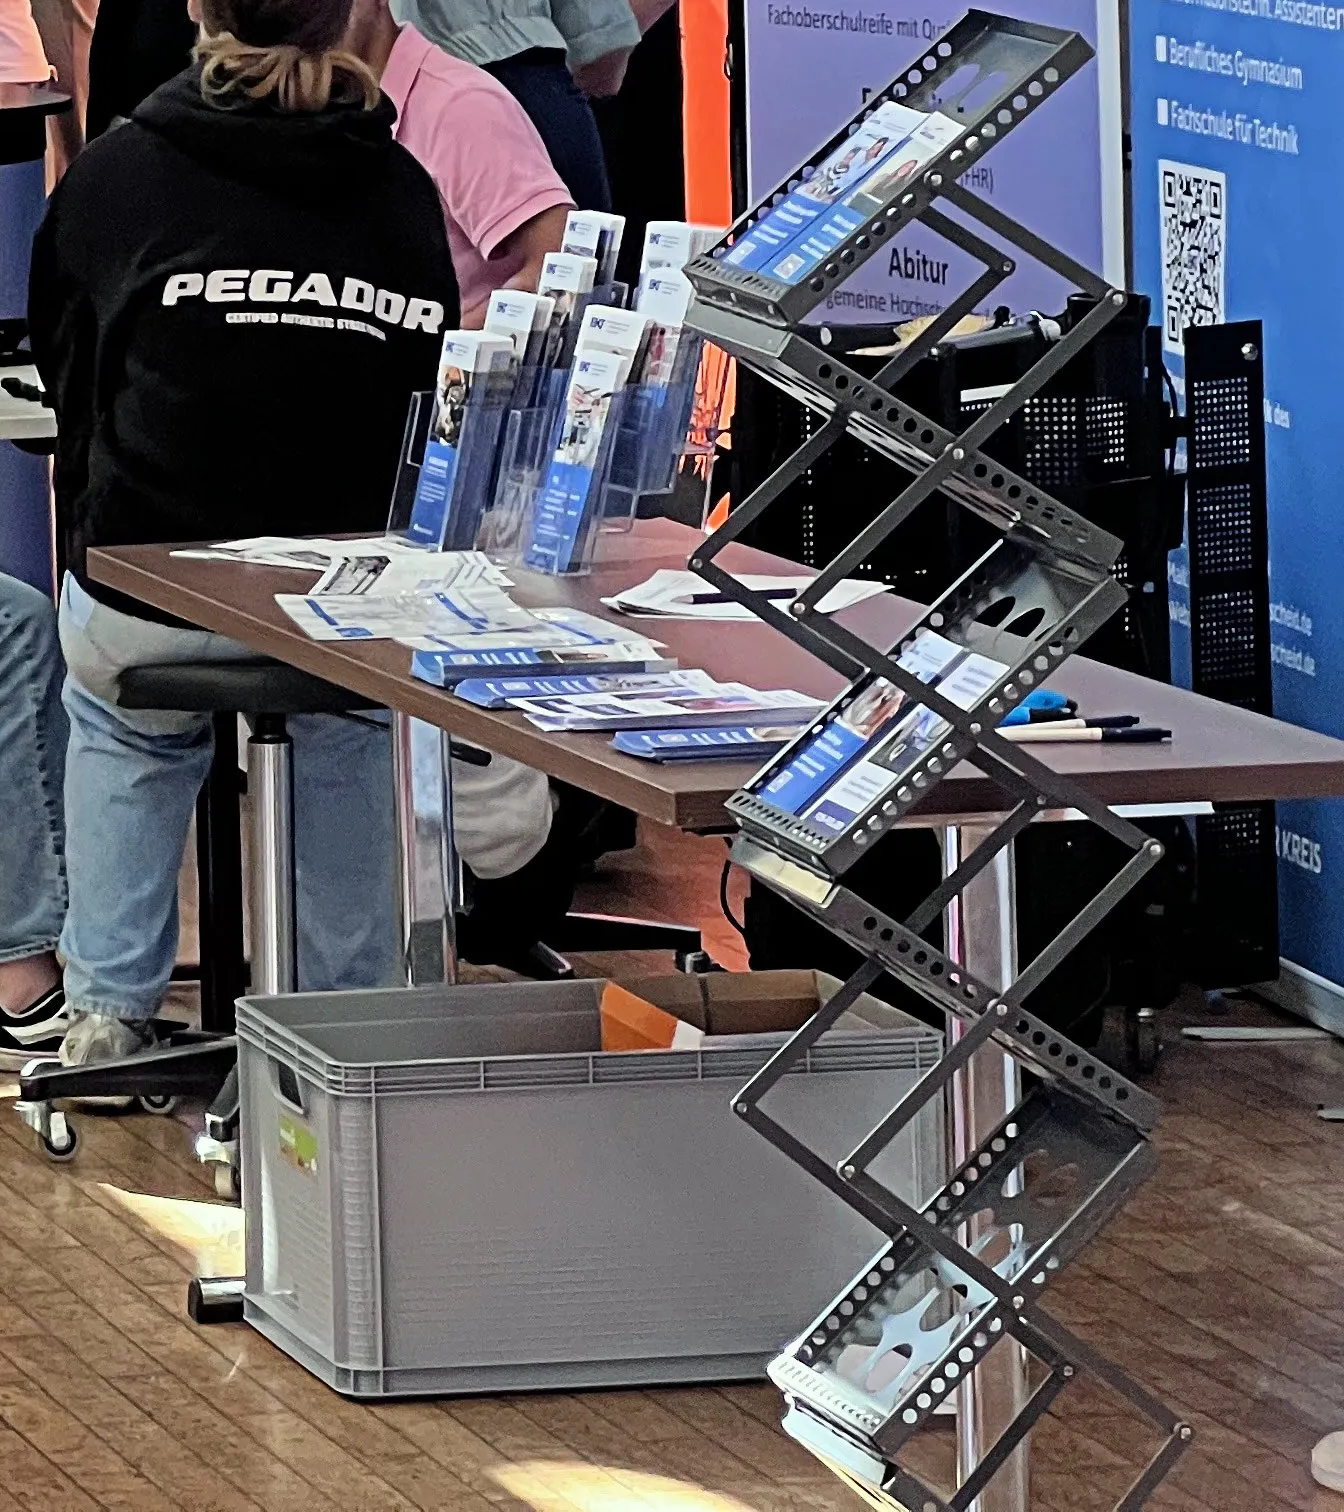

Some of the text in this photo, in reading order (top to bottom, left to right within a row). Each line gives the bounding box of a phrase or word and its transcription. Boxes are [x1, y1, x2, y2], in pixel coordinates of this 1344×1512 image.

[767, 4, 893, 35] Fachoberschulreife
[897, 18, 918, 39] mit
[1235, 50, 1303, 90] Gymnasium
[1170, 100, 1300, 156] Fachschule für Technik
[888, 246, 950, 286] Abitur
[161, 269, 445, 334] PEGADOR
[1282, 830, 1321, 873] KREIS
